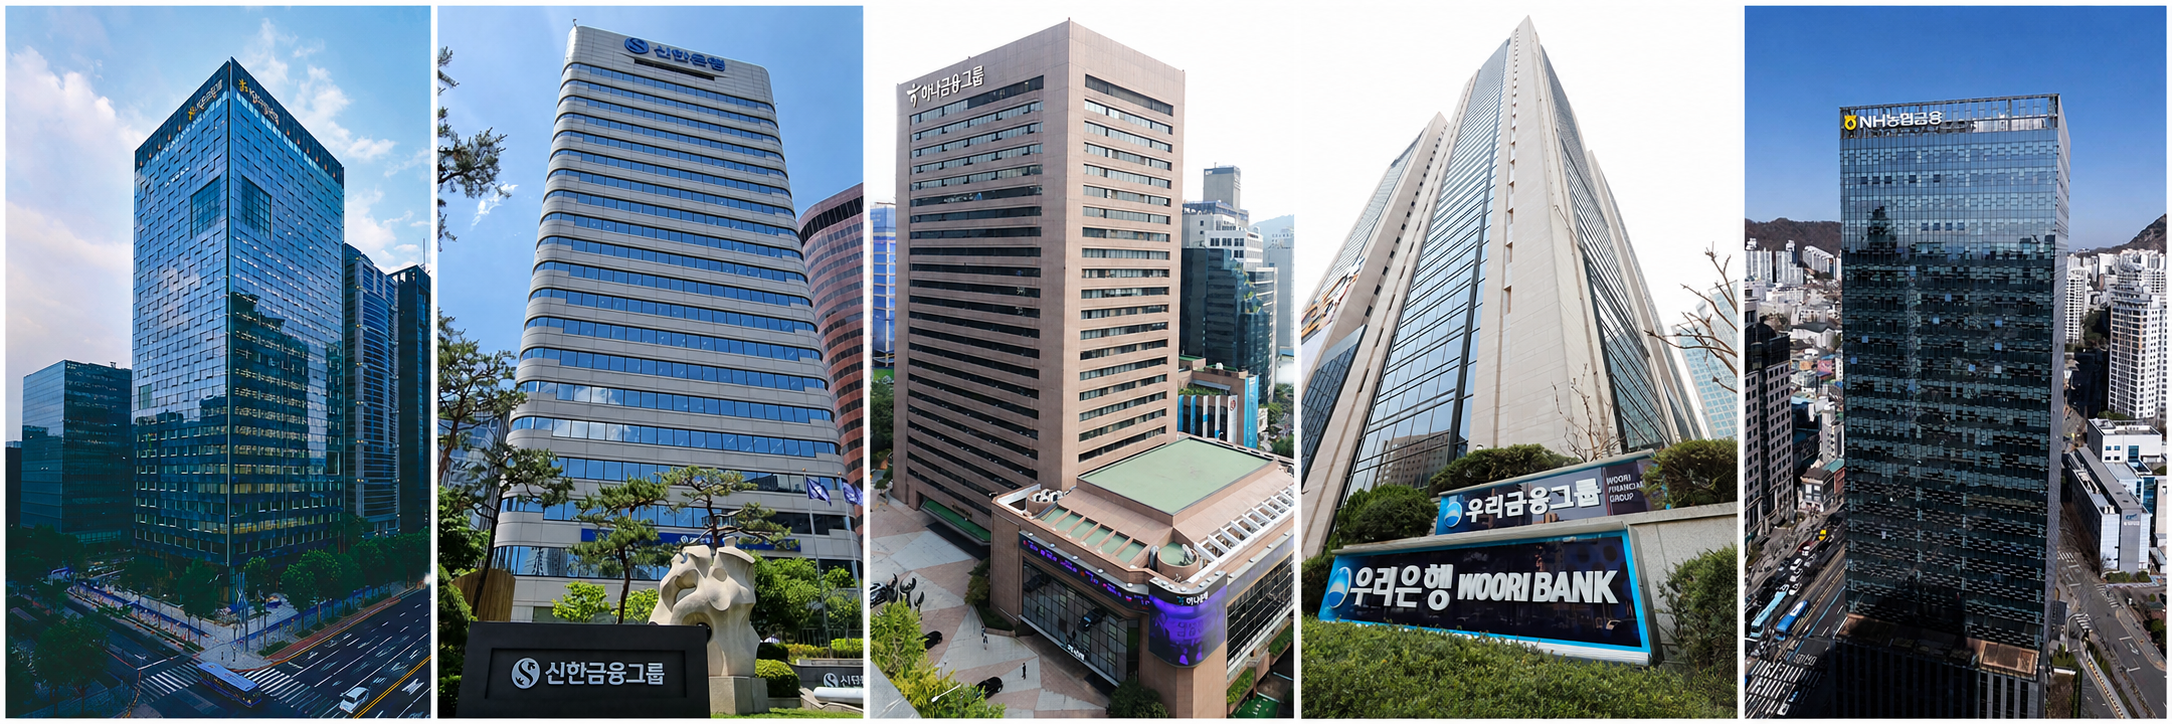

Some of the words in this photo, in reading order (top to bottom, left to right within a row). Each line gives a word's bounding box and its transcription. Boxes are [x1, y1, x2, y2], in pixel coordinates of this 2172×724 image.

[1465, 477, 1603, 523] 우리금융그룹
[1350, 563, 1454, 612] 우리은행
[1457, 572, 1531, 603] WOORI
[1532, 569, 1619, 605] BANK
[544, 661, 666, 686] 신한금융그룹
